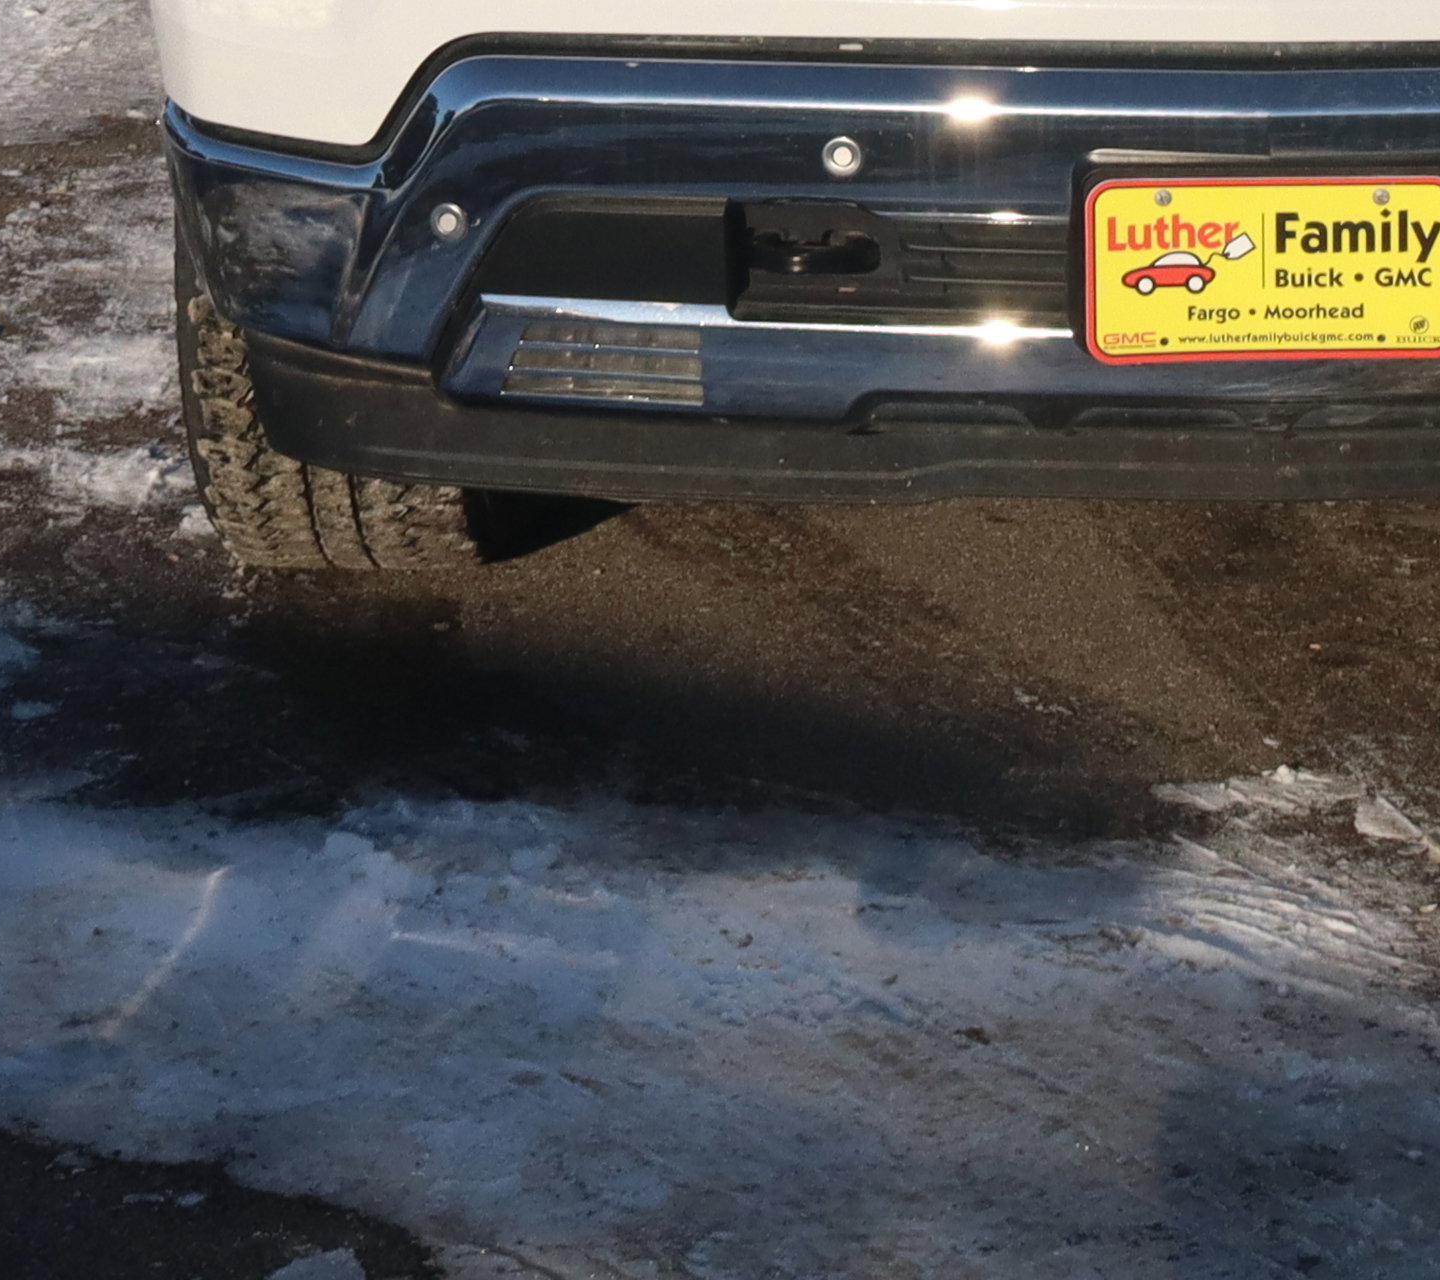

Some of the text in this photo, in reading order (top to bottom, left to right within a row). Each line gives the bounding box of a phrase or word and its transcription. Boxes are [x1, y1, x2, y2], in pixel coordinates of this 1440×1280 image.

[1107, 212, 1240, 252] Luther
[1275, 266, 1433, 288] Buick GMC
[1187, 303, 1365, 324] Fargo Moorhead
[1103, 331, 1156, 345] GMC
[1178, 332, 1375, 346] www.lutherfamilybuickgmc.com
